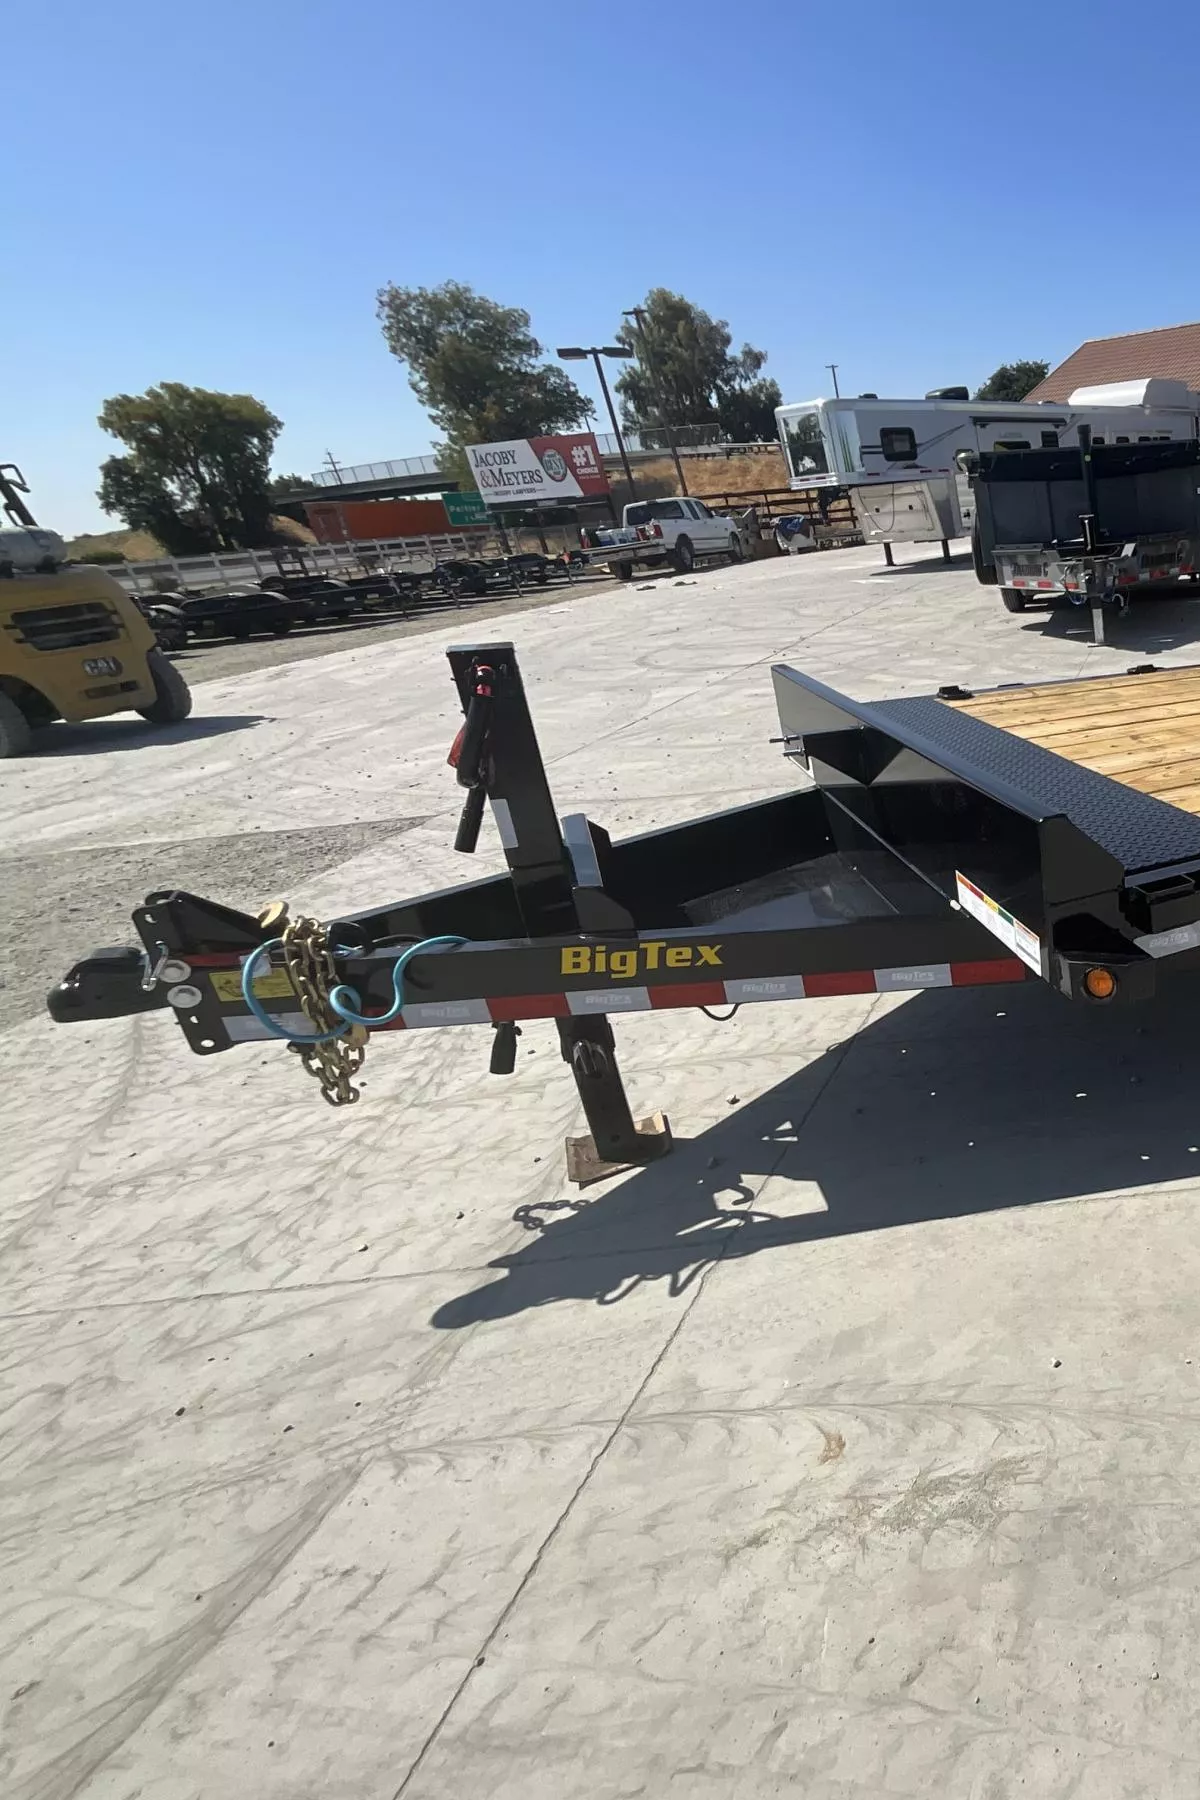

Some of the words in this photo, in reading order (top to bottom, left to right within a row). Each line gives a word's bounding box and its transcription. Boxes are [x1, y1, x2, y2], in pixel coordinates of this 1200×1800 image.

[472, 449, 517, 468] JACOBY
[571, 445, 596, 466] #1
[83, 658, 117, 676] CAT
[560, 941, 723, 979] BigTex
